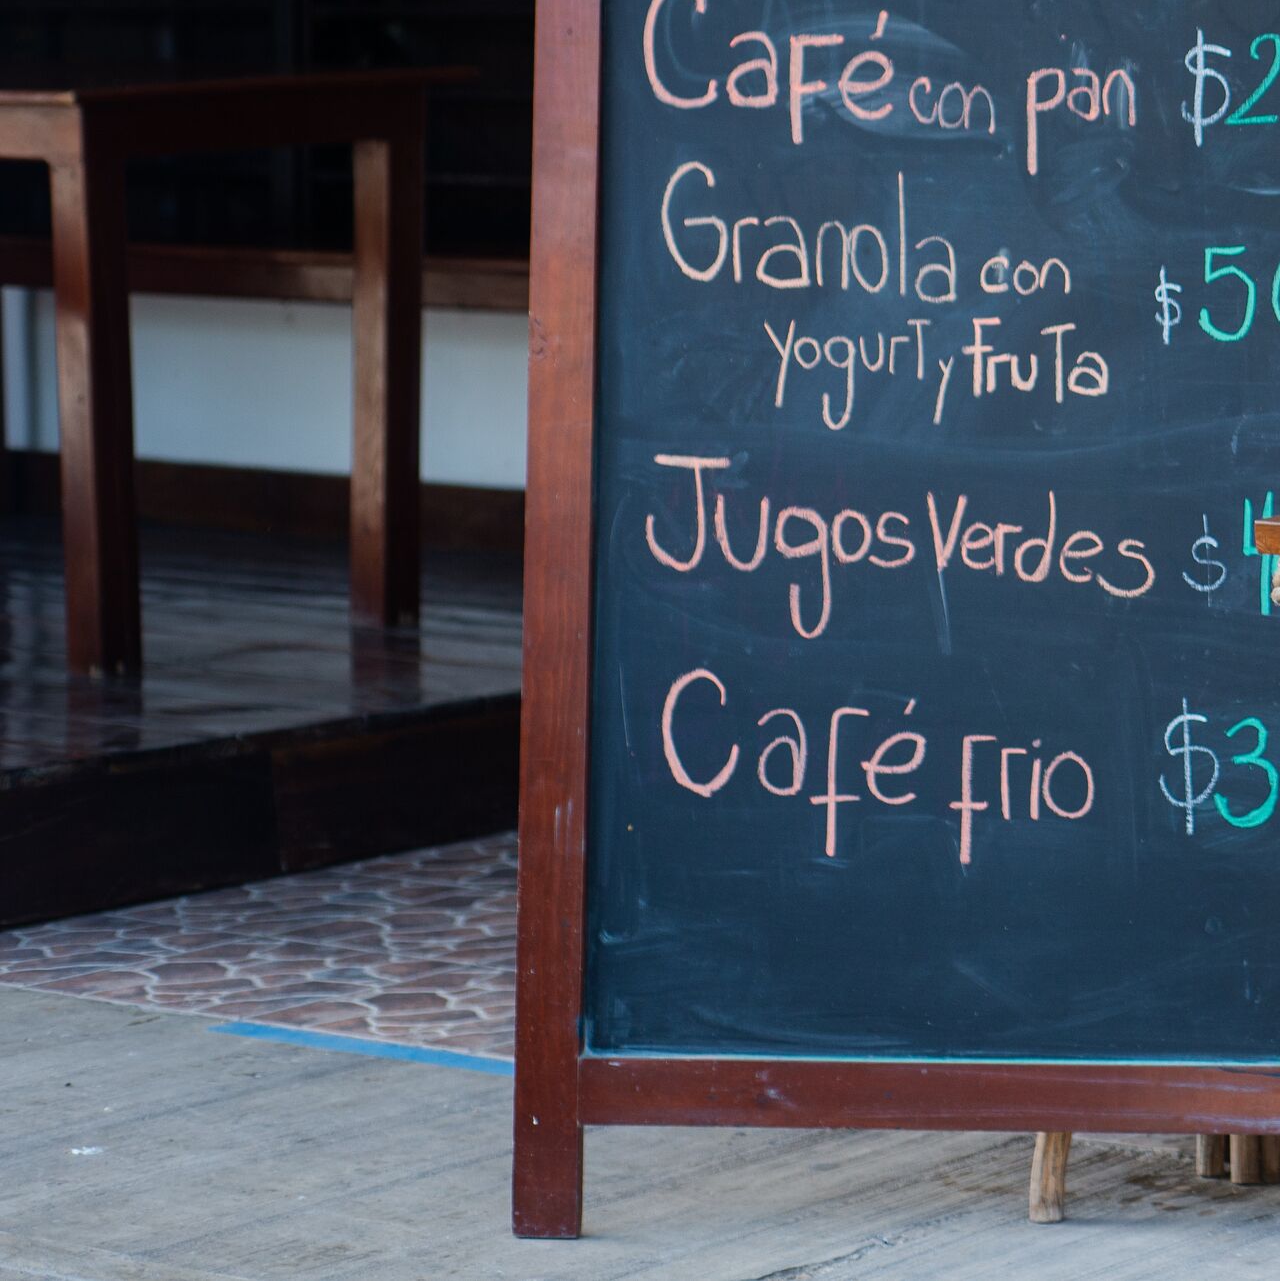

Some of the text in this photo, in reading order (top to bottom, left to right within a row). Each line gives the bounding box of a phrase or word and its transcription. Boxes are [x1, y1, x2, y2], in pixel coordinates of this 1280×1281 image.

[908, 76, 996, 134] con
[1026, 67, 1136, 176] pan
[661, 161, 956, 303] Granola
[980, 256, 1071, 296] con
[645, 454, 916, 639] Jugos
[927, 490, 1156, 598] Verdes
[661, 667, 927, 858] Café
